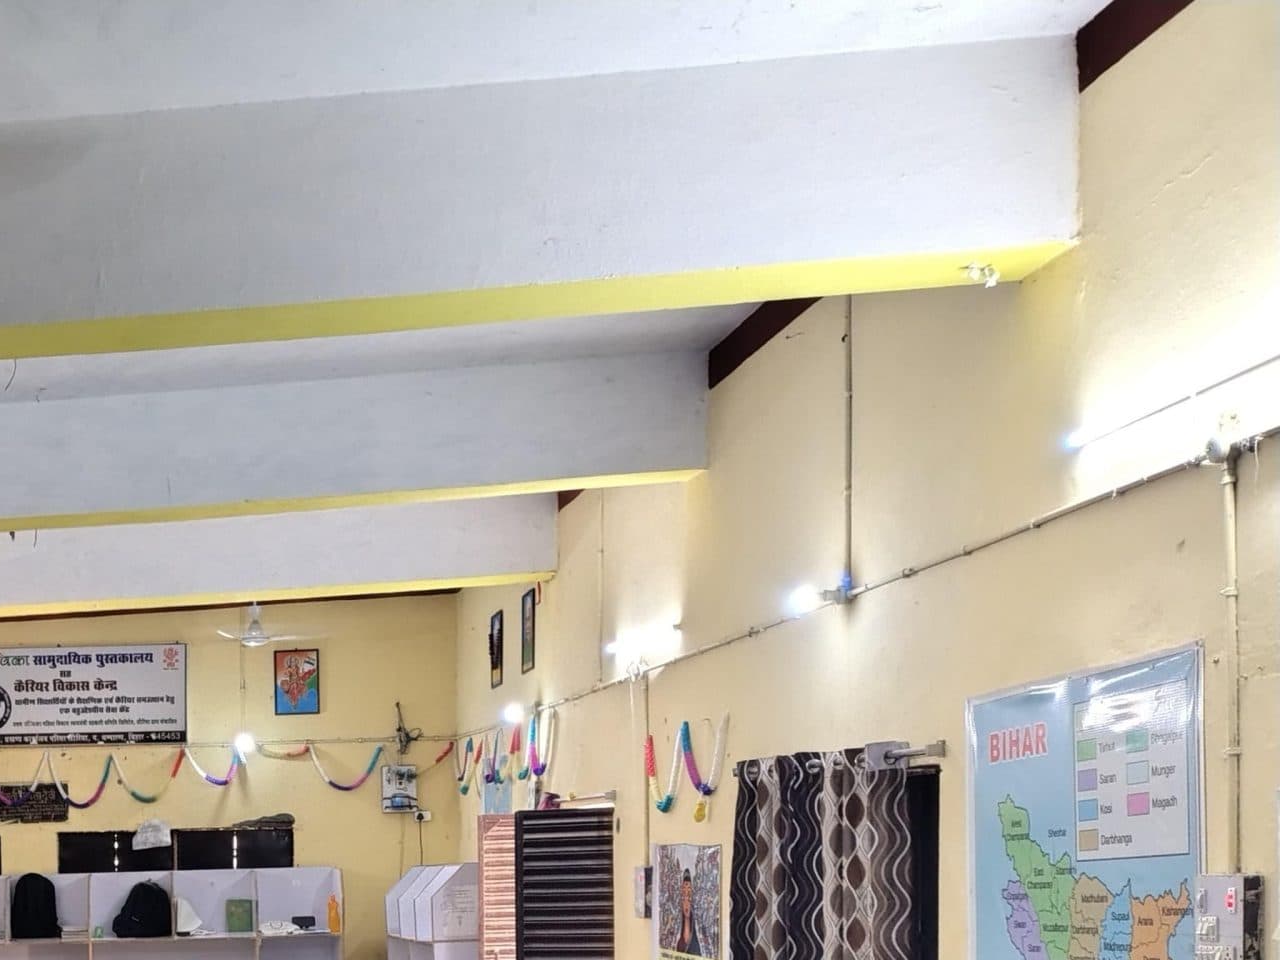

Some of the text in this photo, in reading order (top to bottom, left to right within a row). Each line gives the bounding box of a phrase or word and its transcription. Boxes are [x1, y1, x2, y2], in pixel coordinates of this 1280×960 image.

[32, 651, 92, 669] सामुदायिक
[95, 652, 154, 668] पुस्तकालय
[53, 679, 90, 691] विकास
[93, 677, 118, 691] केन्द्र
[989, 723, 1047, 763] BIHAR
[1151, 764, 1176, 778] Munger
[1099, 773, 1117, 784] Saran
[1151, 796, 1178, 808] Magadh
[1100, 803, 1113, 815] Kosi
[1100, 834, 1133, 846] Darbhanga
[1111, 911, 1130, 922] Supaul
